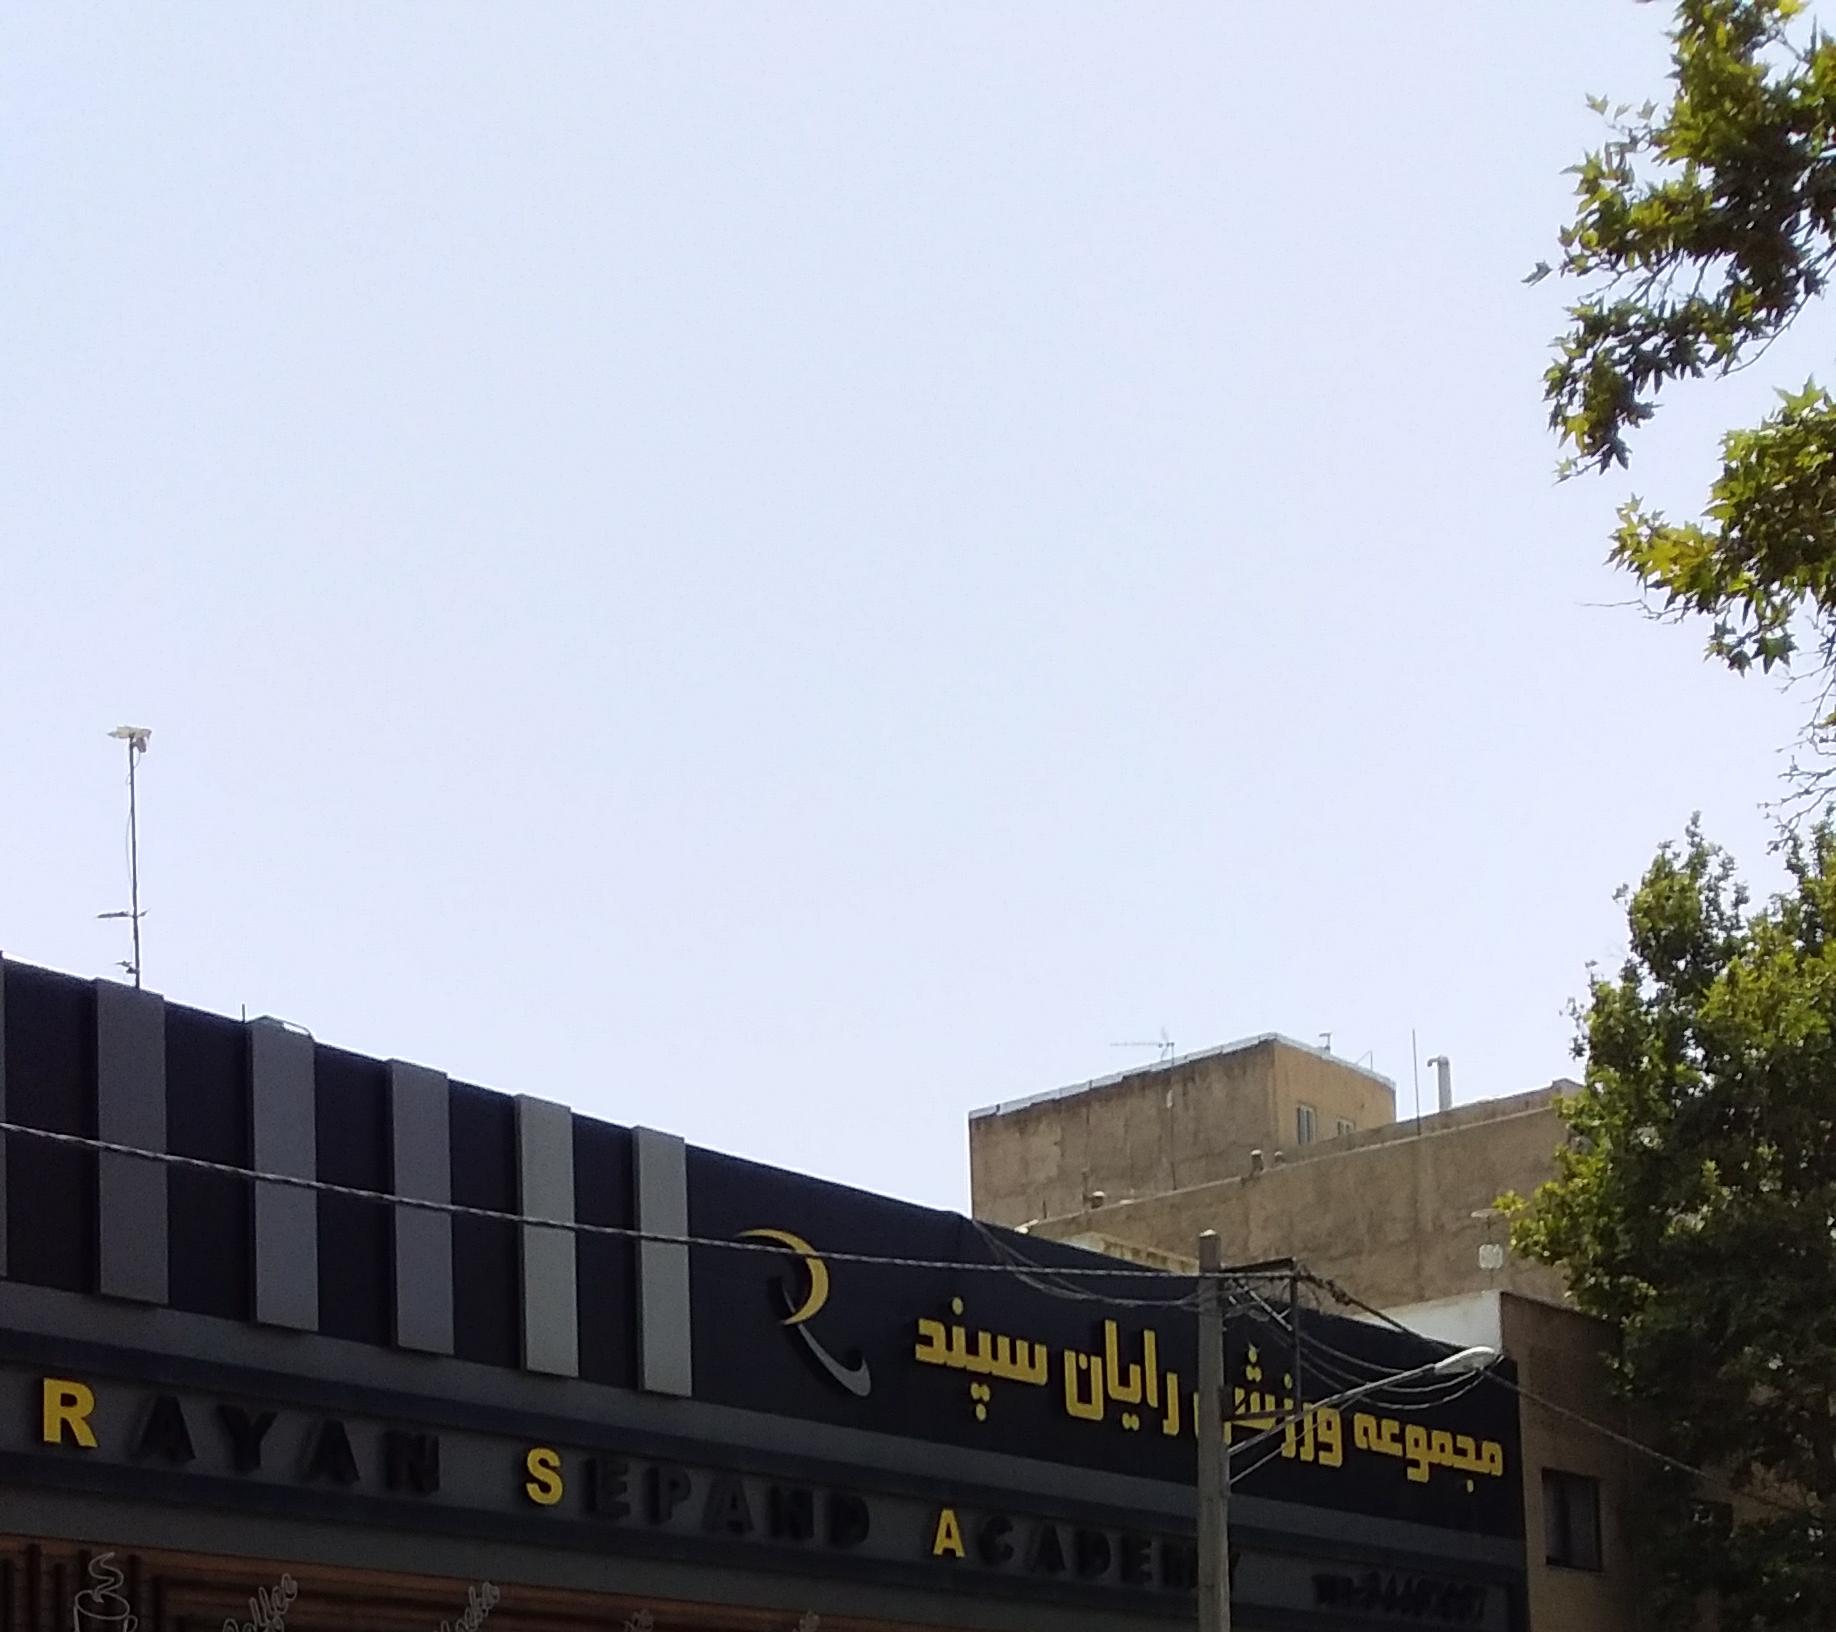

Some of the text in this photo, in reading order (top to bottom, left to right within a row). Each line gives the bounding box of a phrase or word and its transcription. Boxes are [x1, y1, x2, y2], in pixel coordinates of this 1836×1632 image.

[914, 1296, 1049, 1421] سپند
[1063, 1318, 1180, 1438] رایان
[40, 1374, 1240, 1592] RAYAN SEPAND ACADEM
[1353, 1412, 1504, 1493] مجموعه
